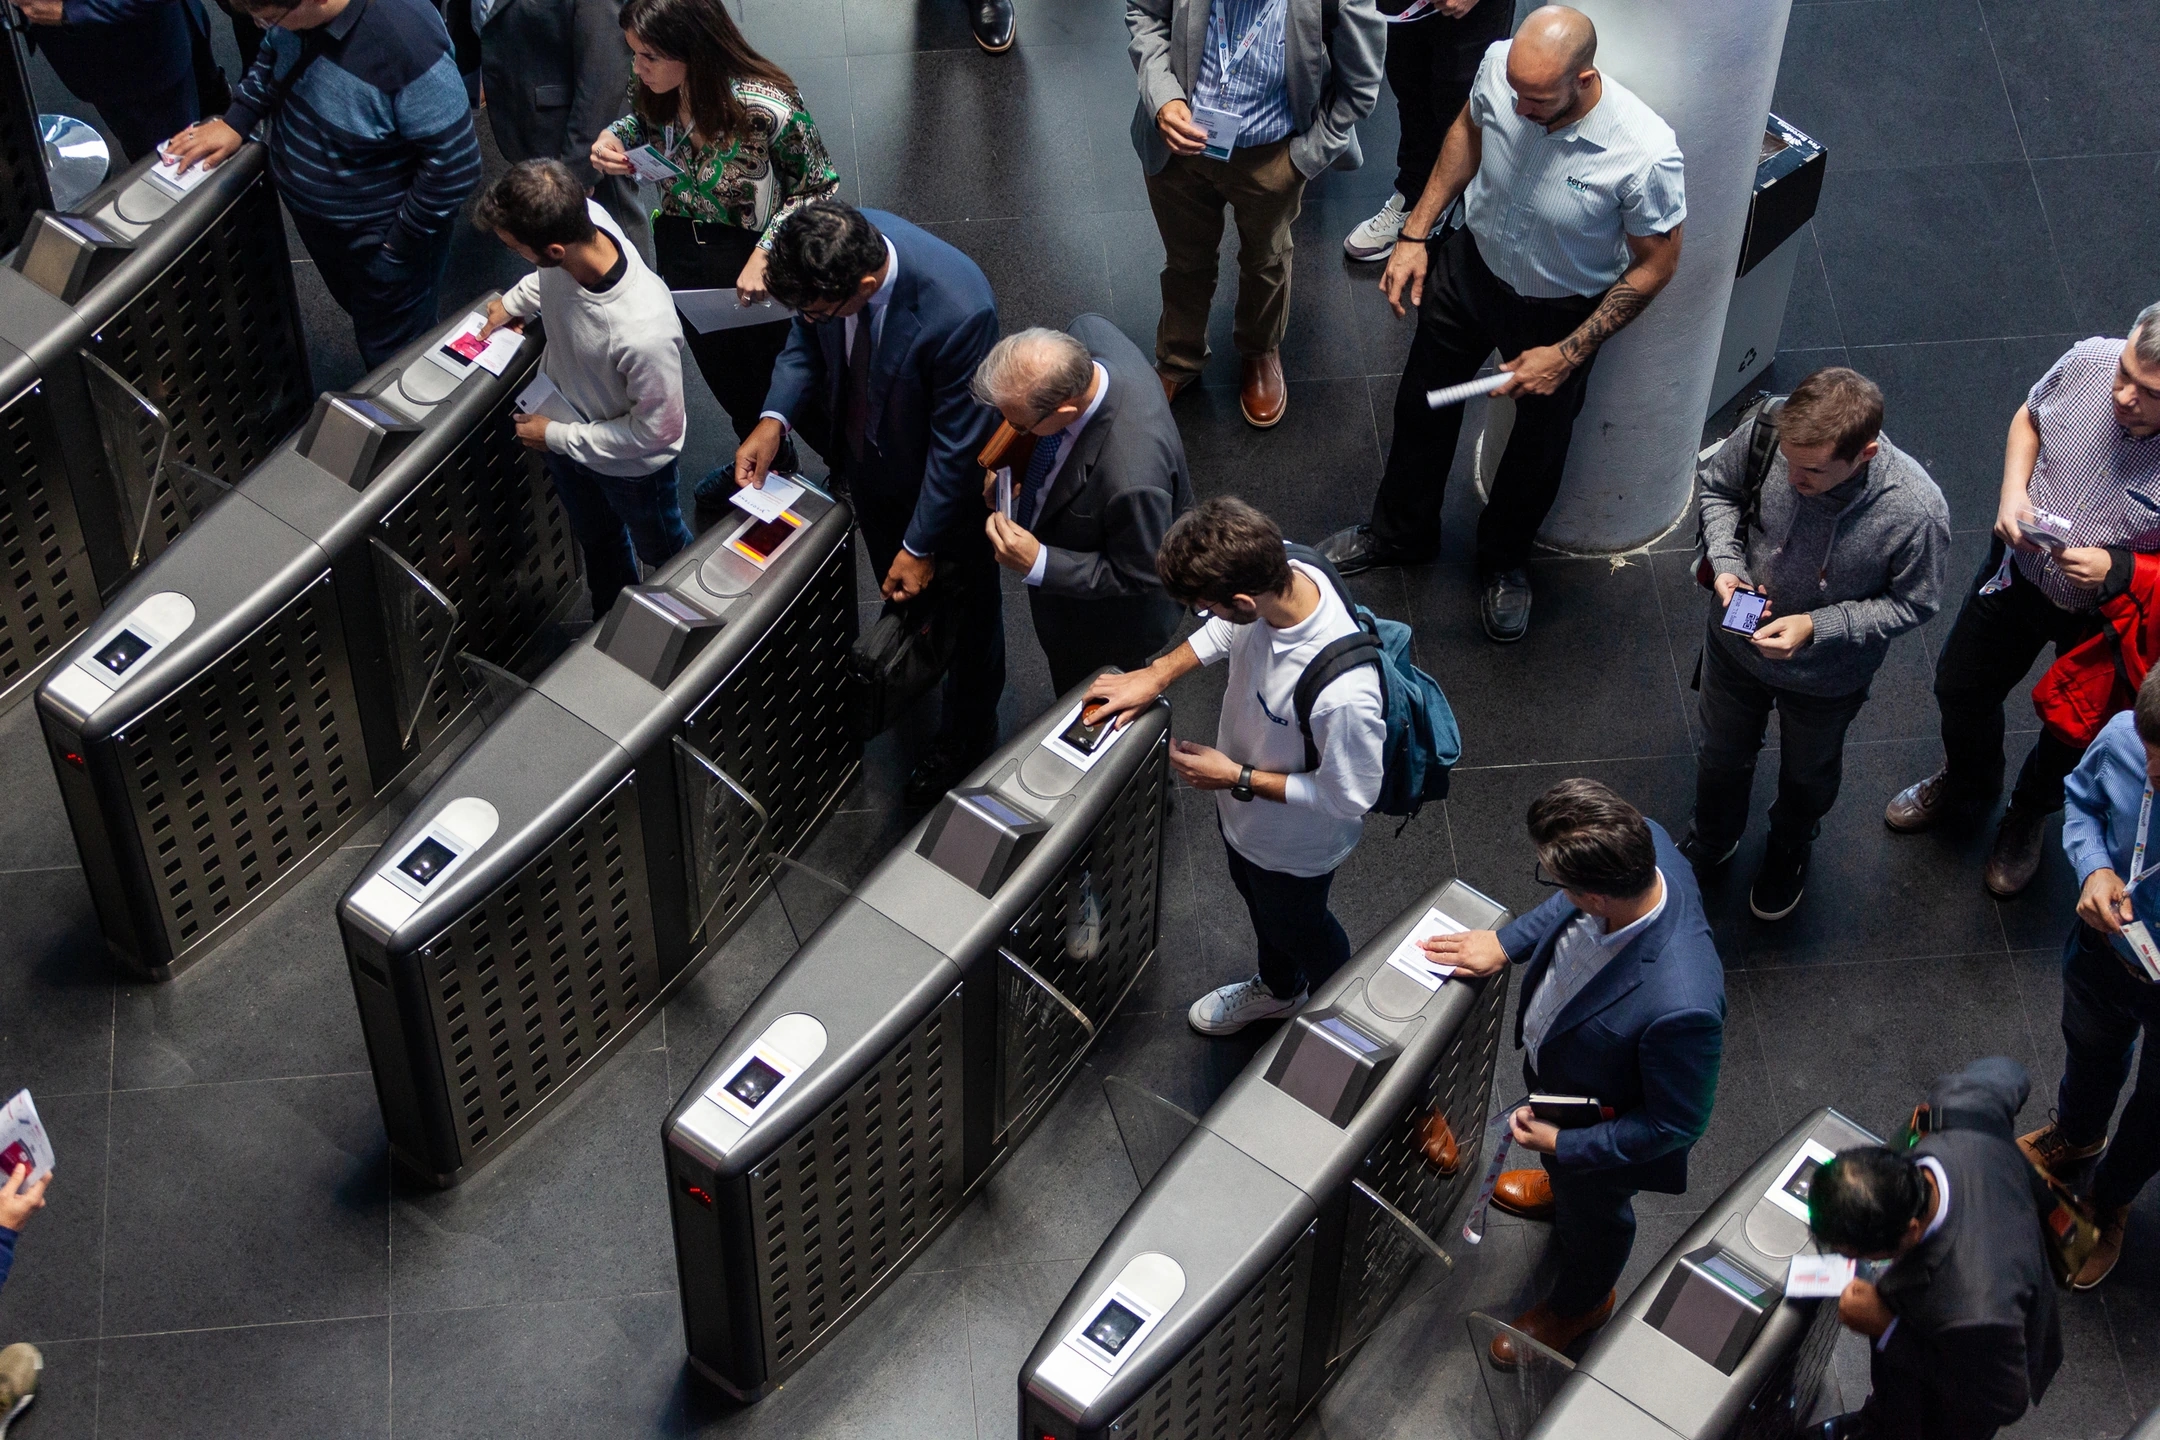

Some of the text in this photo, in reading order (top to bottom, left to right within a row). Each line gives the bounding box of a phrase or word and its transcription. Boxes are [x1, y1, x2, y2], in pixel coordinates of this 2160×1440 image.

[1777, 120, 1821, 150] Fira Barcelona
[2139, 800, 2150, 827] Microsoft
